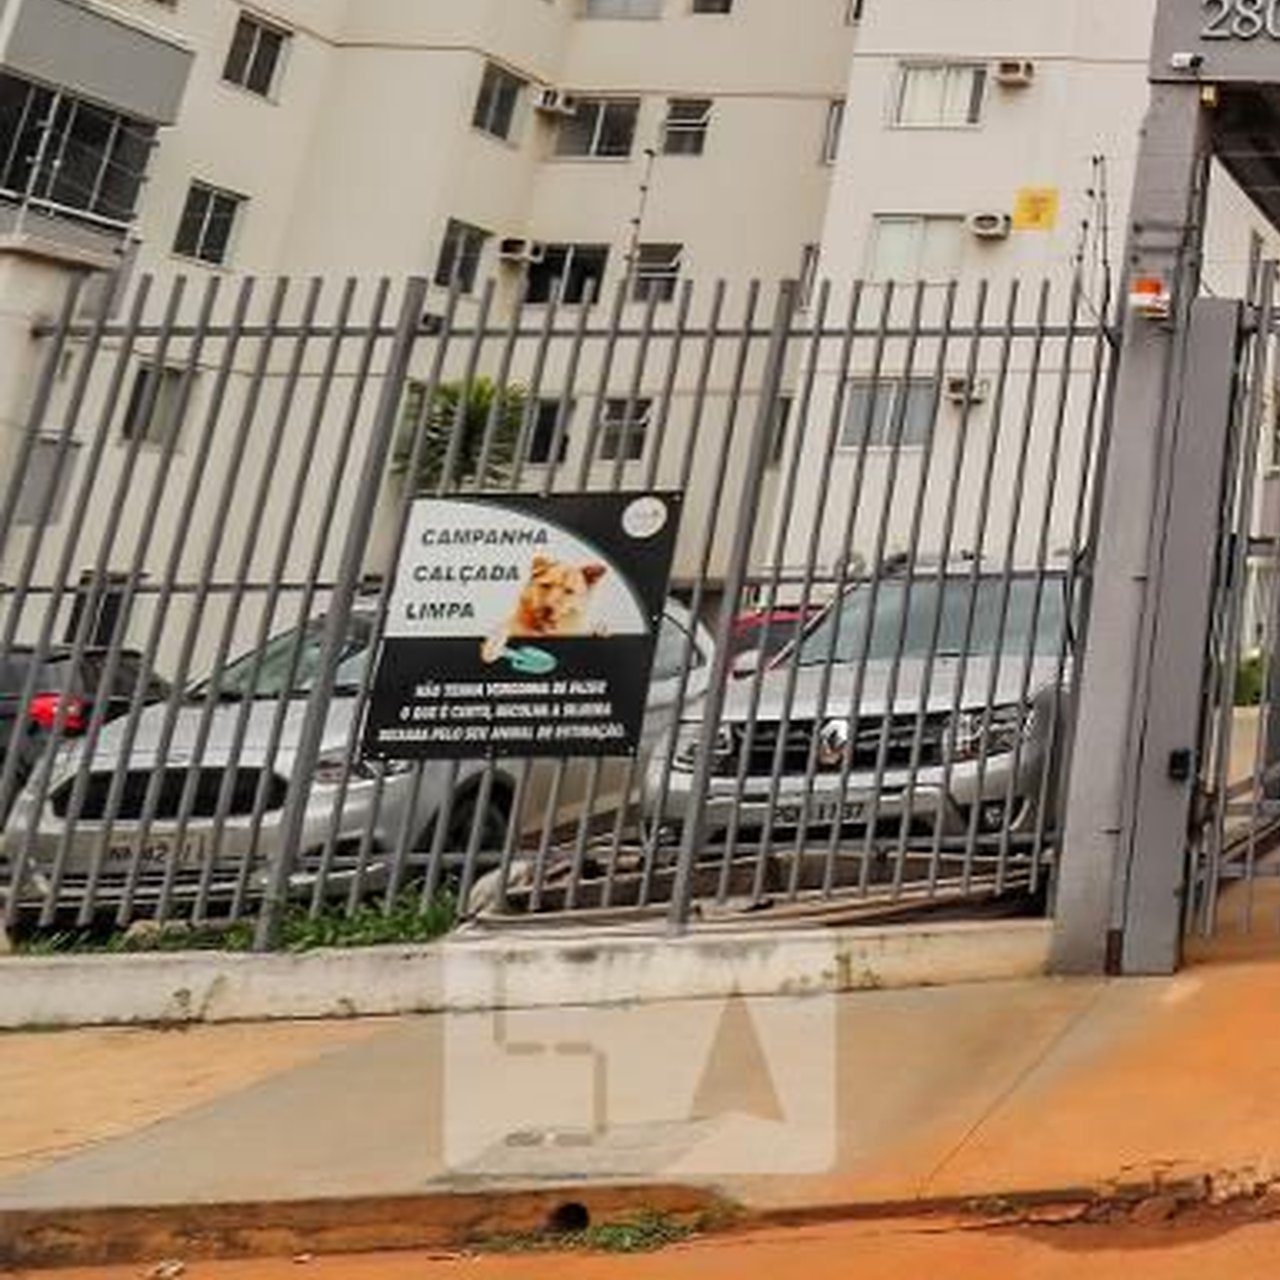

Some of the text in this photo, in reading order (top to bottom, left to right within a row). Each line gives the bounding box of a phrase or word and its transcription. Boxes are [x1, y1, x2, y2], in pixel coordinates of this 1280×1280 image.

[421, 529, 548, 545] CAMPANHA
[413, 565, 520, 585] CALÇADA
[405, 603, 474, 620] LIMPA
